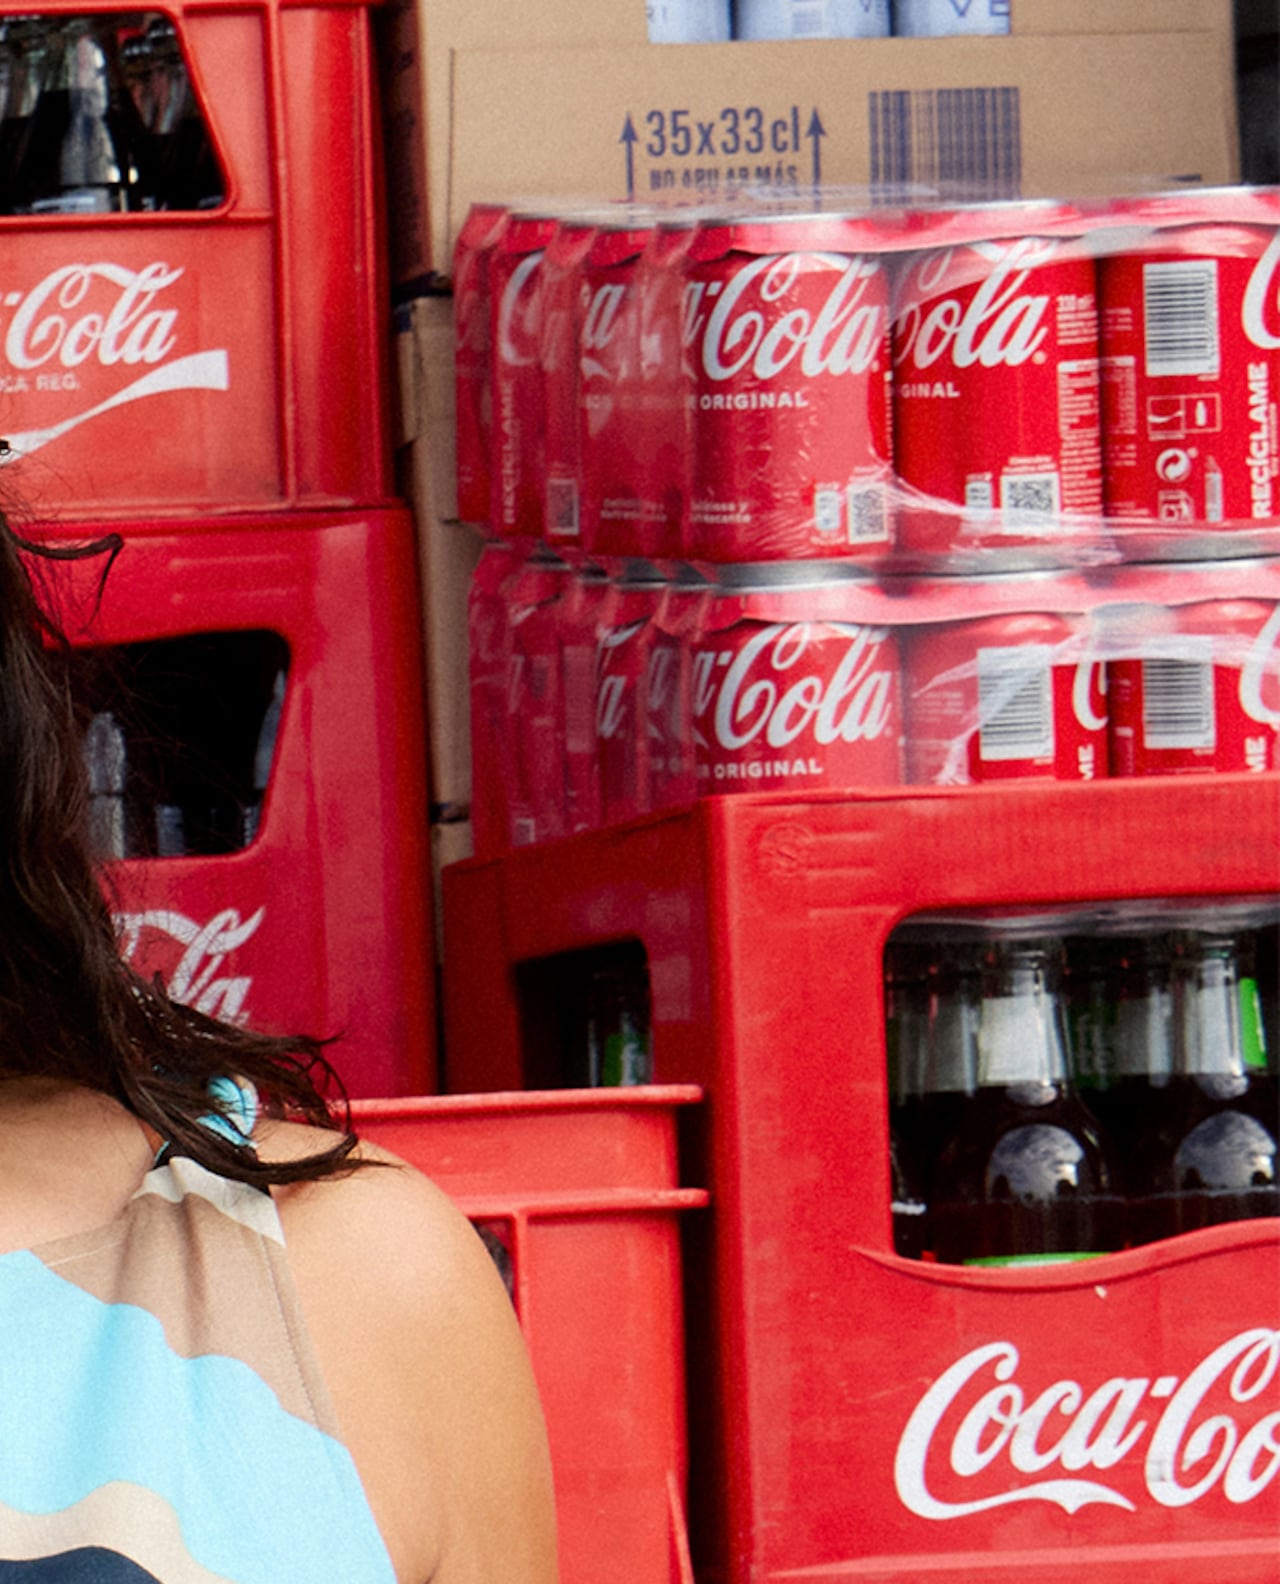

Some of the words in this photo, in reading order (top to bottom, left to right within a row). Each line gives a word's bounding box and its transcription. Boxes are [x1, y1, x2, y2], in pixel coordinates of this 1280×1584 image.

[646, 106, 800, 157] 35x33cl
[36, 373, 81, 393] REG.
[699, 391, 809, 410] ORIGINAL
[714, 758, 824, 780] ORIGINAL
[894, 1327, 1280, 1521] Coca-Co
